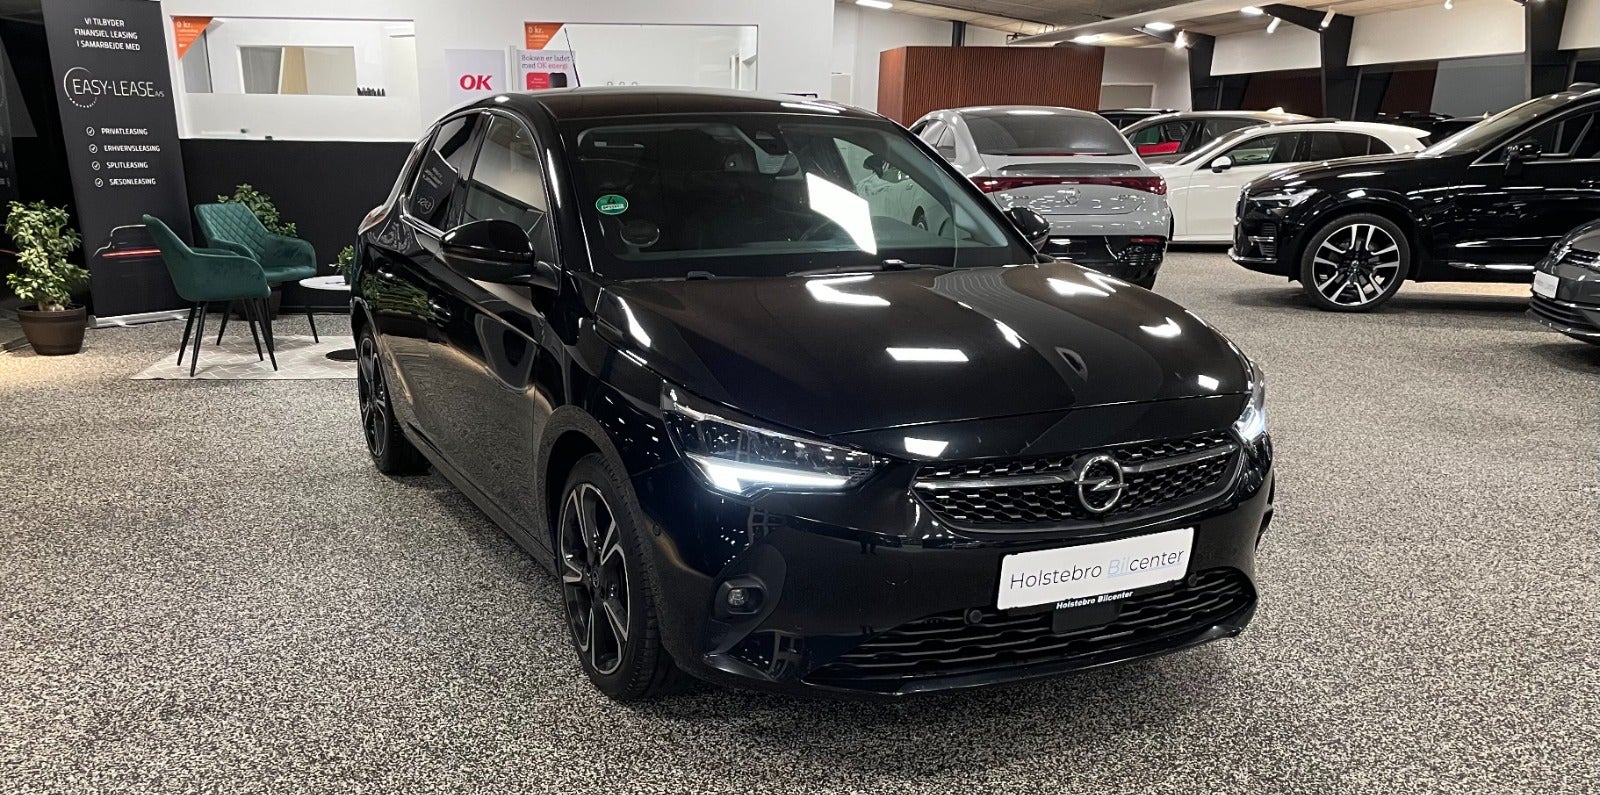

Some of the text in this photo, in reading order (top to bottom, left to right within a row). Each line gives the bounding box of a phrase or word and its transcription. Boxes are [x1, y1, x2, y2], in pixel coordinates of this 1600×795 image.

[84, 17, 125, 27] VI TILBYDER
[74, 28, 138, 40] FINANSIEL LEASING
[80, 40, 125, 50] SAMARBEJDE
[125, 42, 141, 51] MED
[72, 78, 155, 97] EASY-LEASE
[459, 74, 492, 91] OK
[100, 127, 148, 136] PRIVATLEASING
[103, 145, 161, 153] ERHVERVSLEASING
[106, 161, 149, 170] SPLITLEASING
[109, 178, 157, 187] SÆSONLEASING
[1009, 549, 1185, 591] Holstebro Bilcenter
[1055, 590, 1134, 611] Holstebro Bilcenter
